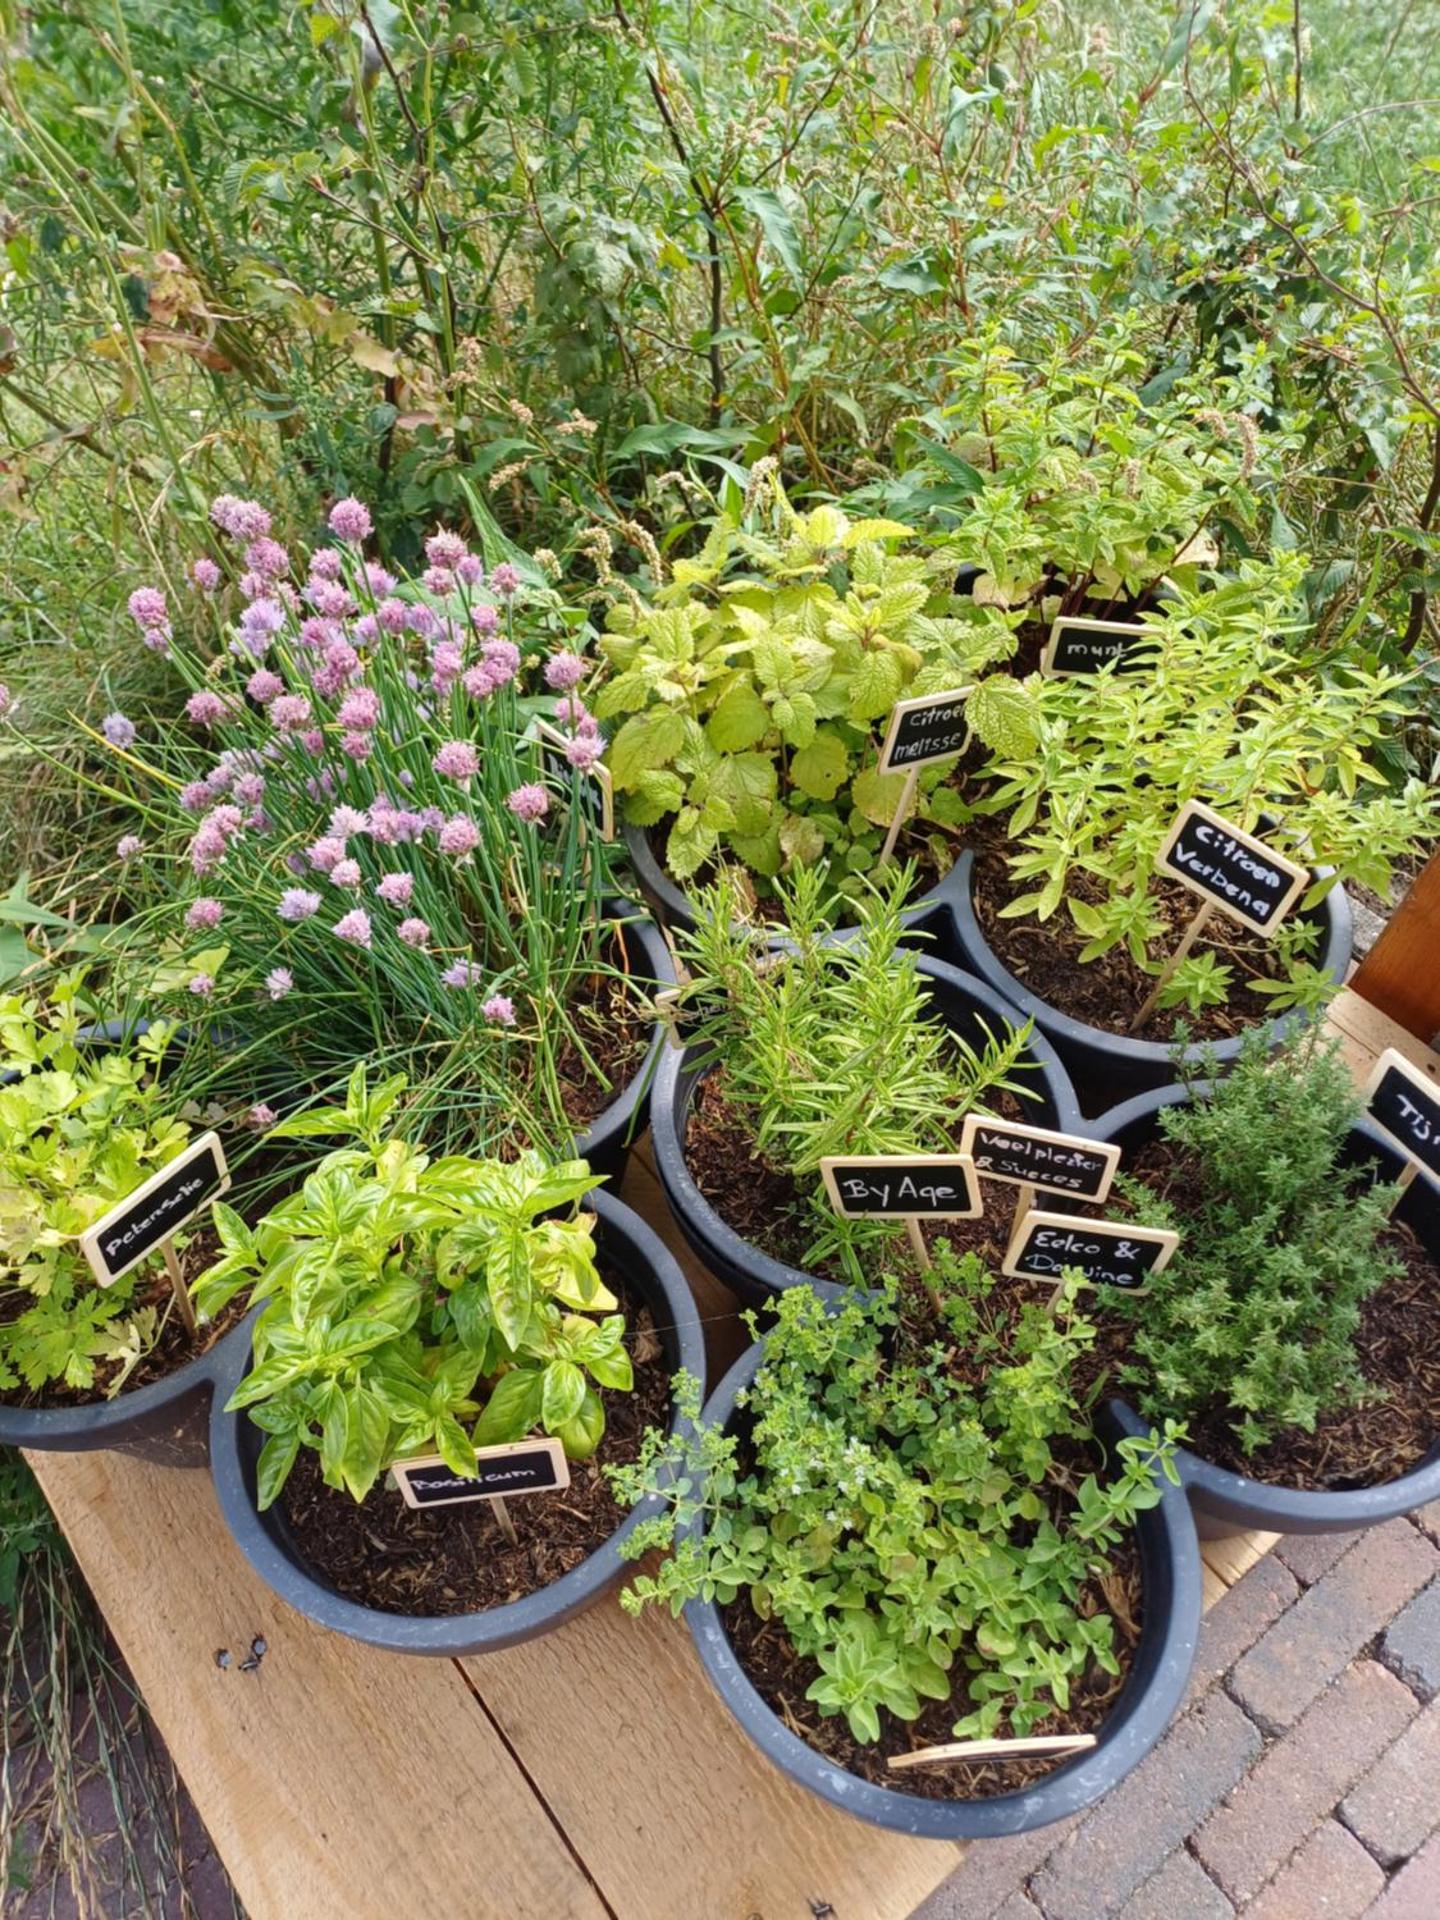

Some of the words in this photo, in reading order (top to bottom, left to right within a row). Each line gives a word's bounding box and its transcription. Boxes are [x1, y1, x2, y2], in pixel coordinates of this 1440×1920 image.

[1195, 825, 1281, 888] Citroen
[1176, 842, 1270, 917] Verbena
[975, 1156, 993, 1172] &
[842, 1179, 890, 1208] By
[1114, 1241, 1140, 1260] &
